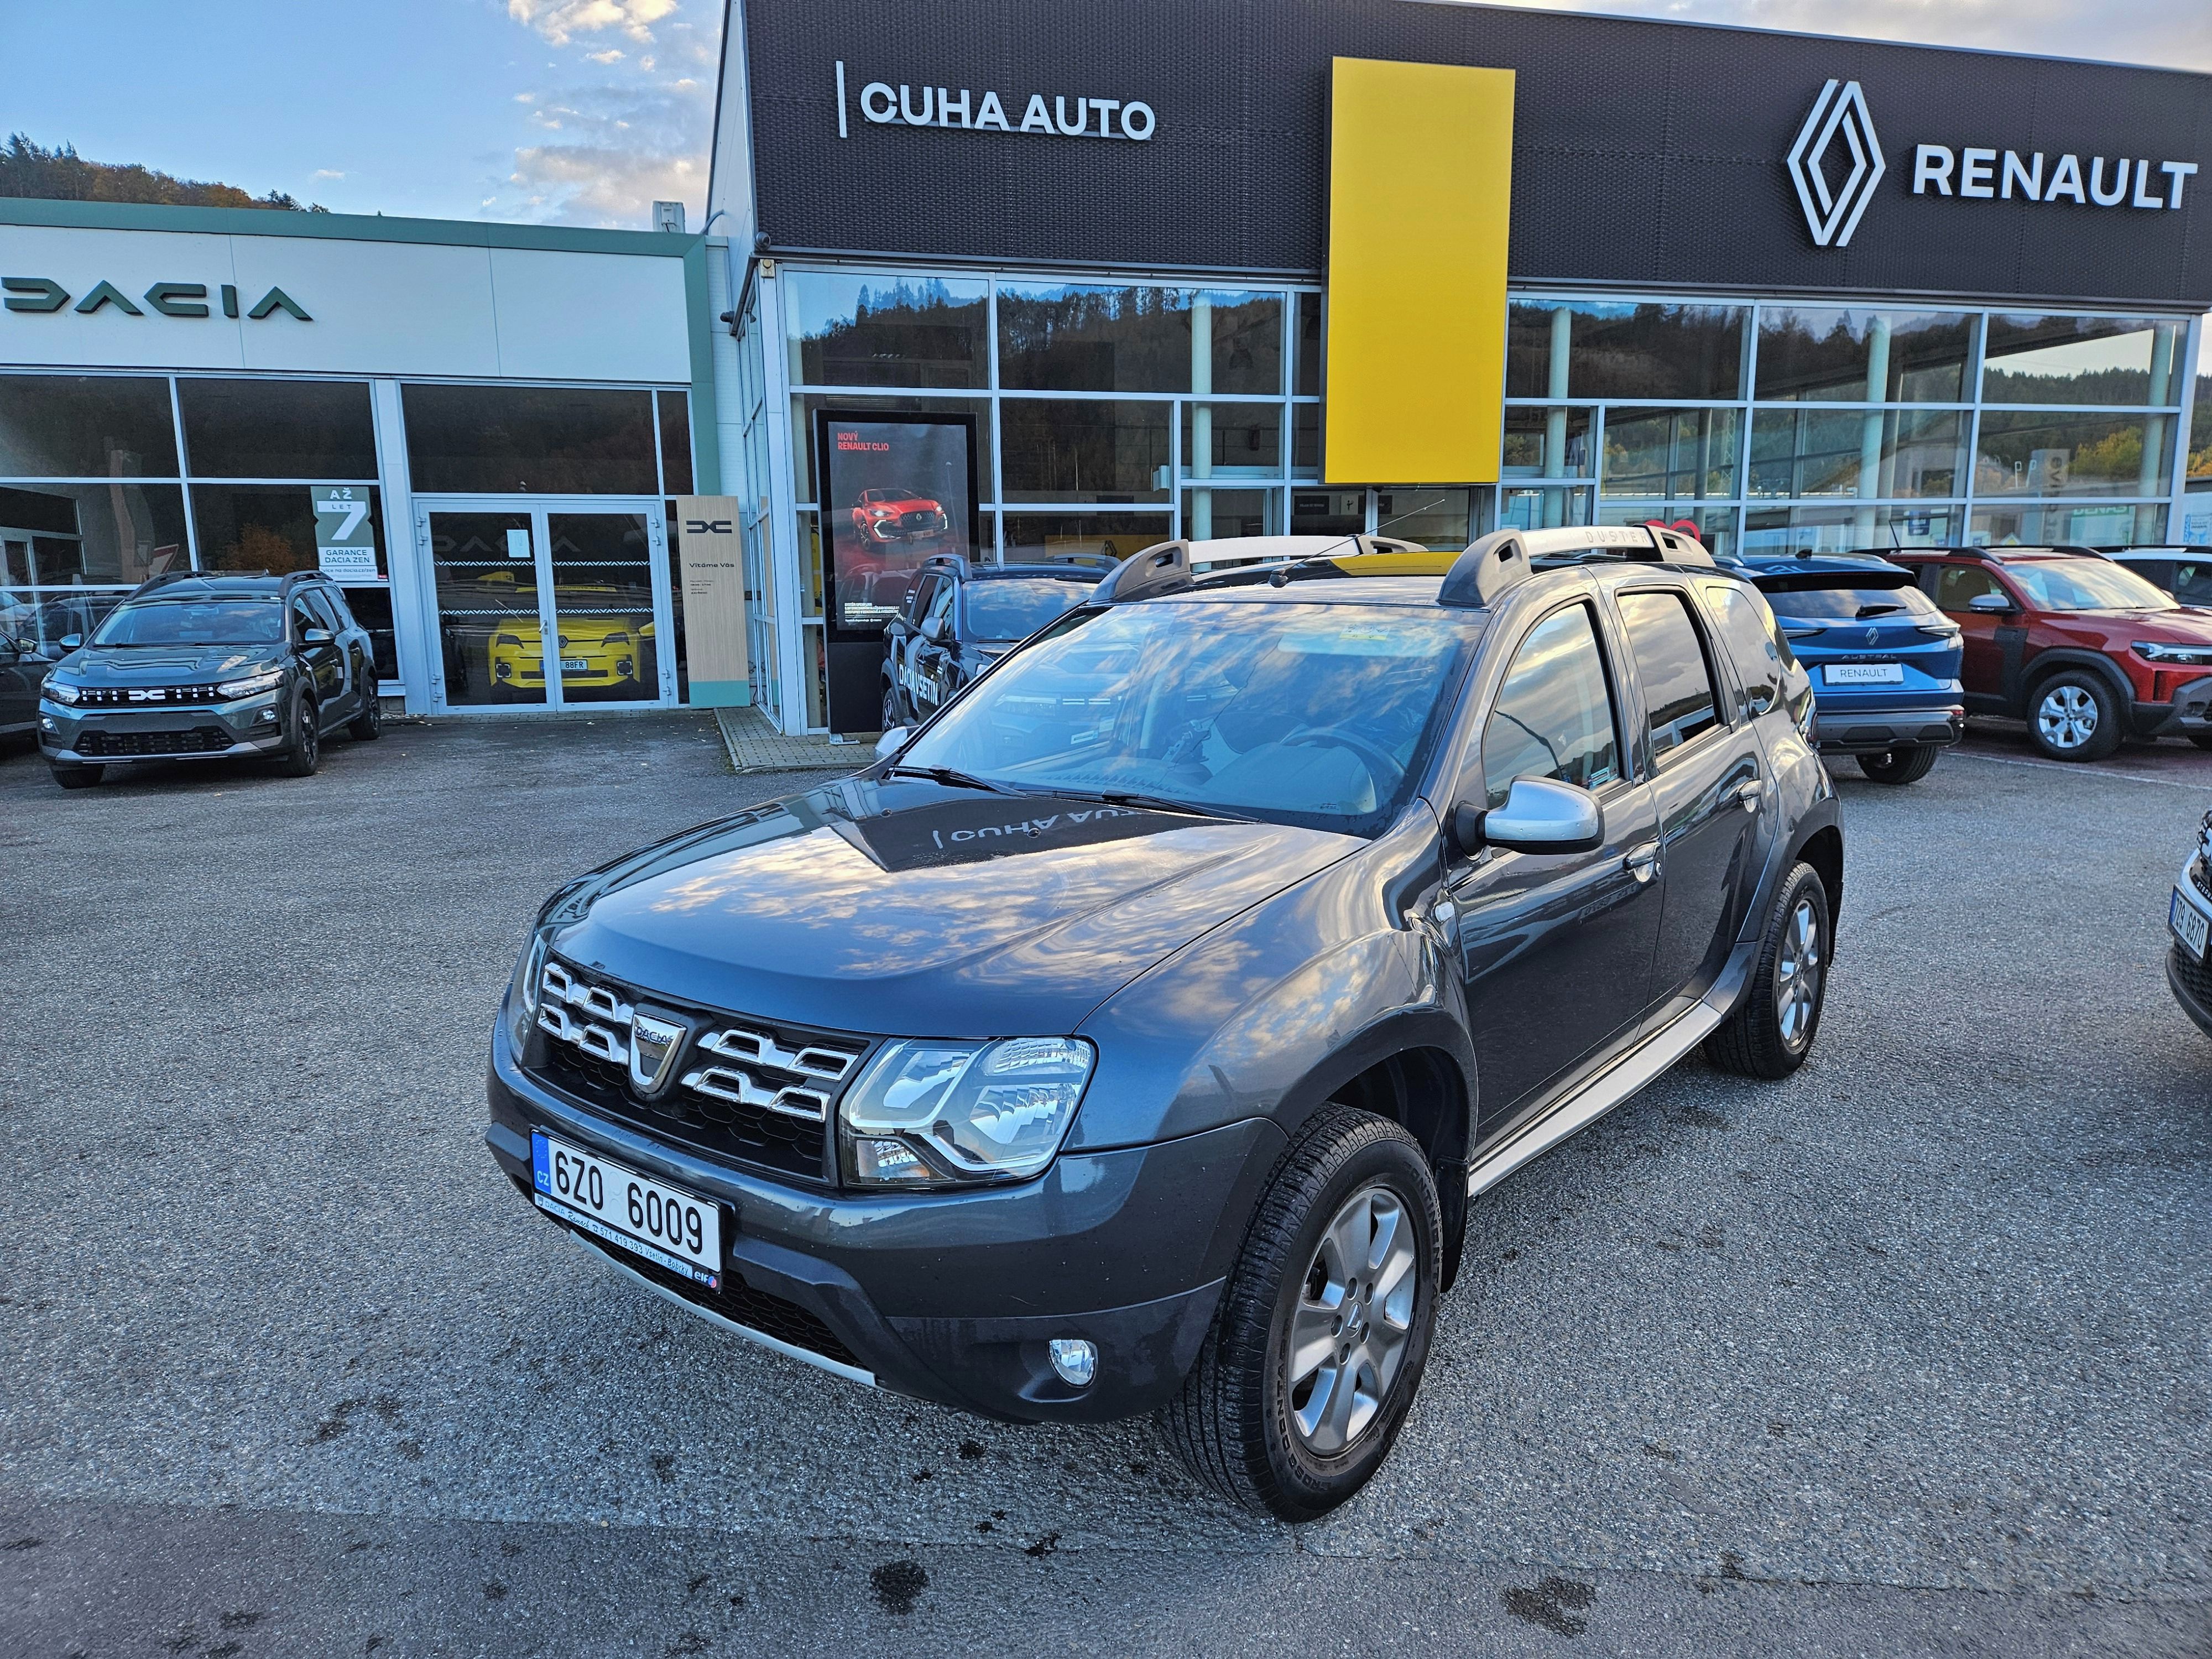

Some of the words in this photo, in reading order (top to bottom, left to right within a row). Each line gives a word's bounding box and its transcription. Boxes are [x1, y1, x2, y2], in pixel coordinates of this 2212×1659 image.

[860, 81, 1011, 132] CUHA
[1019, 94, 1156, 140] AUTO
[1913, 144, 2199, 209] RENAULT
[1, 277, 314, 322] DACIA
[837, 431, 858, 441] NOVÝ
[838, 442, 871, 450] RENAULT
[872, 443, 889, 451] CLIO
[330, 487, 352, 499] AŽ
[316, 500, 367, 540] 7
[1585, 530, 1648, 544] DUSTER
[565, 661, 584, 669] 88FR
[1840, 669, 1888, 677] RENAULT
[915, 672, 938, 706] VSETÍN
[2186, 911, 2205, 951] 6870
[635, 1026, 669, 1046] DACIA
[536, 1170, 550, 1187] CZ
[627, 1182, 703, 1255] 6009
[545, 1201, 565, 1215] DACIA
[600, 1226, 612, 1240] 571
[614, 1234, 628, 1247] 419
[629, 1241, 643, 1254] 393
[667, 1258, 688, 1275] Bobrky
[694, 1270, 709, 1284] elf
